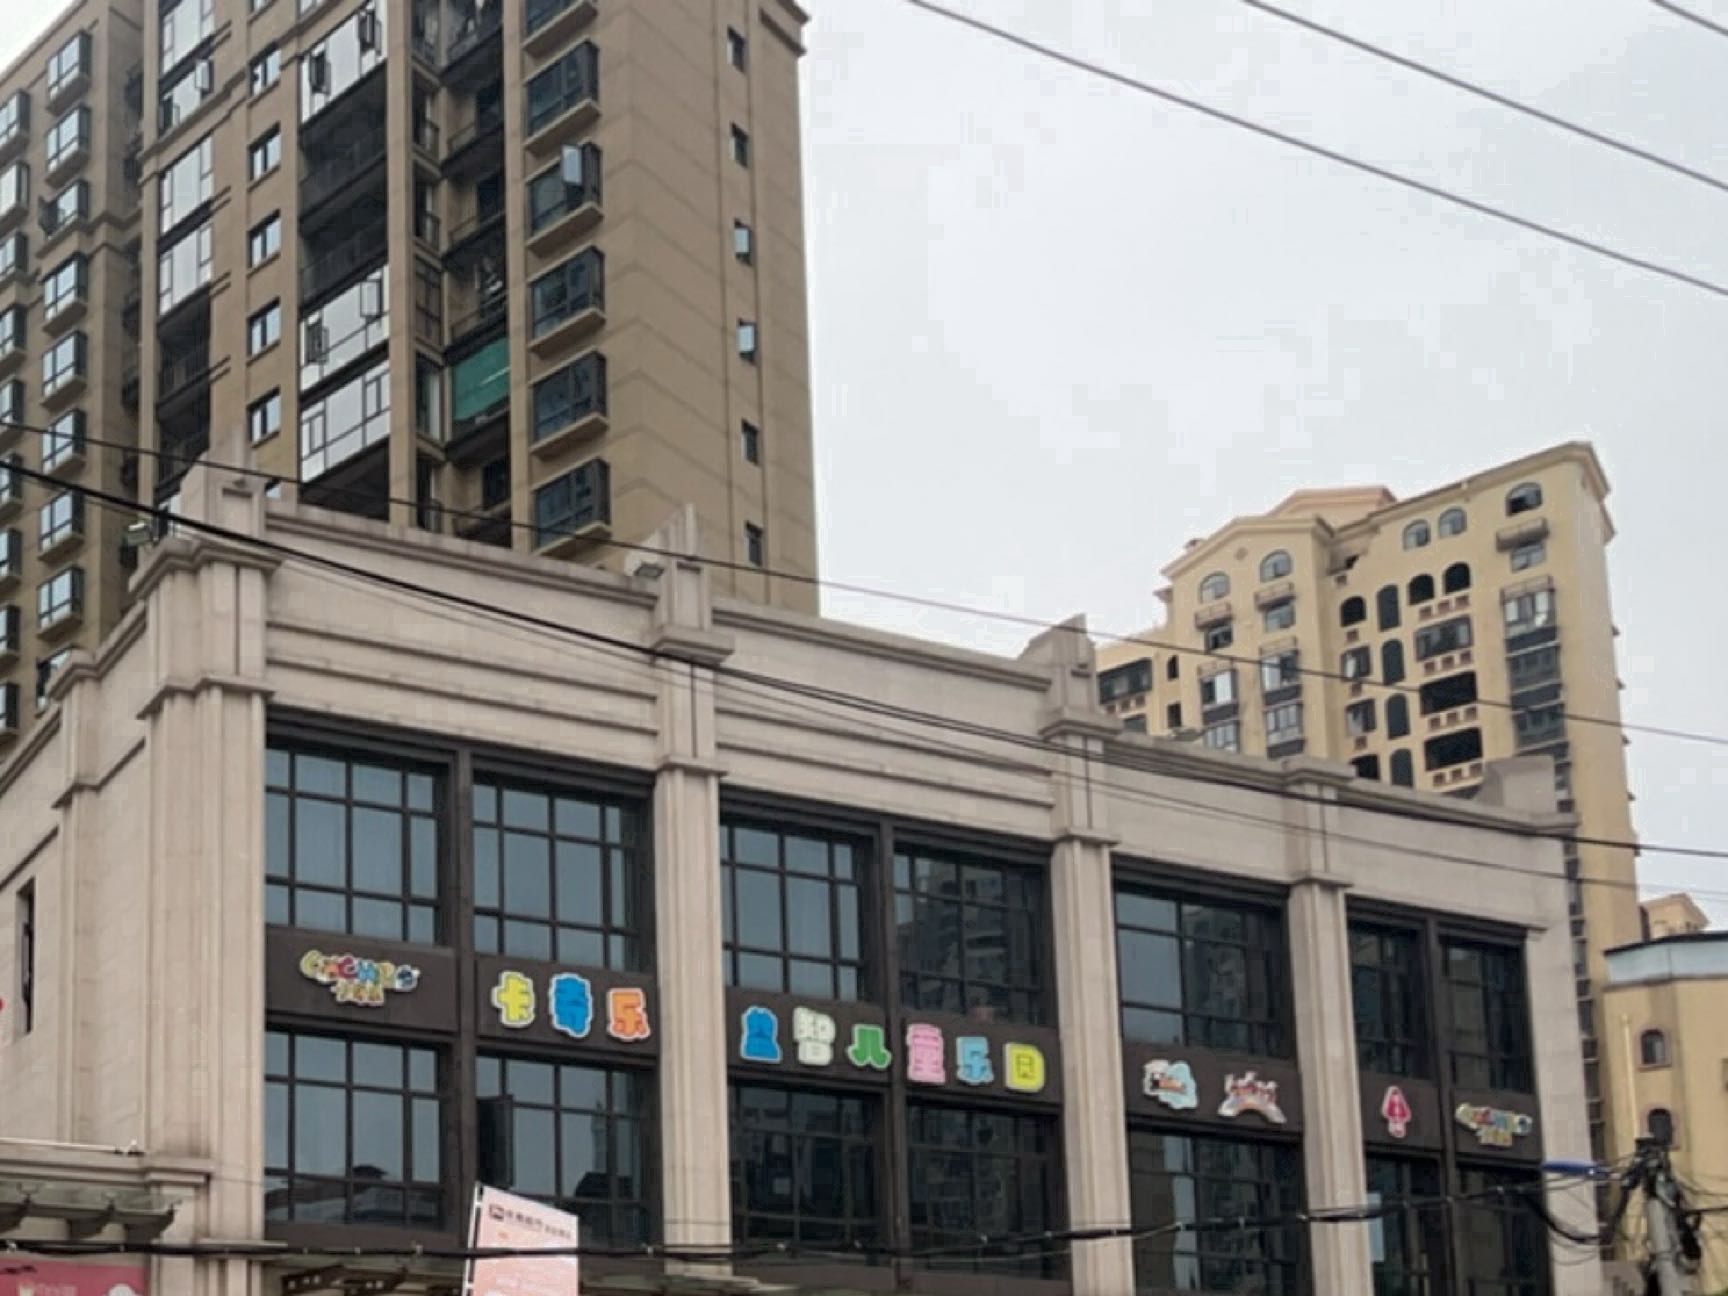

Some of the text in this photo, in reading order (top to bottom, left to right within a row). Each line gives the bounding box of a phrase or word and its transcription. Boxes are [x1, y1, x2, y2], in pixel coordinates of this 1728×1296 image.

[740, 1005, 1046, 1093] 益智儿童乐园
